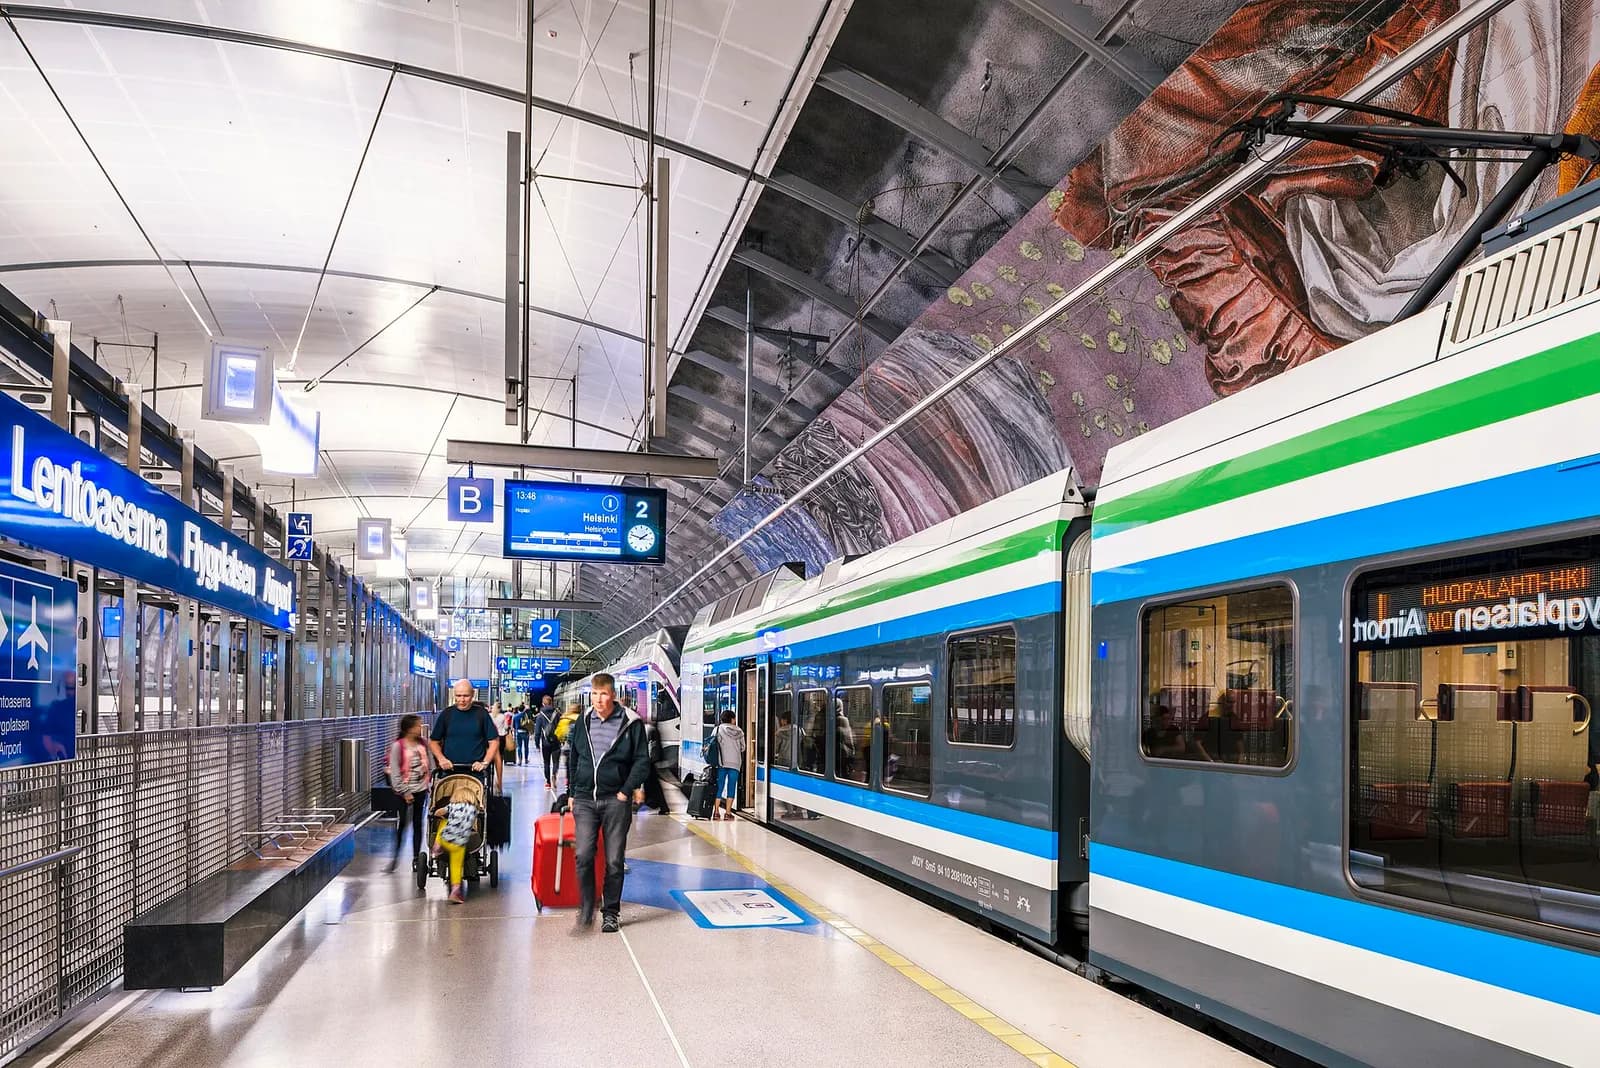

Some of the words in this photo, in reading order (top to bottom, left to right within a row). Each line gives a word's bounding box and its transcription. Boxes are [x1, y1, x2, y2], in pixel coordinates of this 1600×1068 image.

[459, 486, 482, 514] B
[583, 512, 618, 524] Helsinki
[635, 501, 648, 518] 2
[11, 425, 168, 559] Lentoasema
[183, 520, 256, 592] Flygplatsen
[263, 567, 292, 616] Airport
[584, 525, 618, 534] Helsingfors
[1423, 567, 1588, 606] HUOPALAHTI-HKI
[538, 623, 553, 643] 2
[448, 638, 458, 649] C
[0, 718, 29, 735] gplatsen
